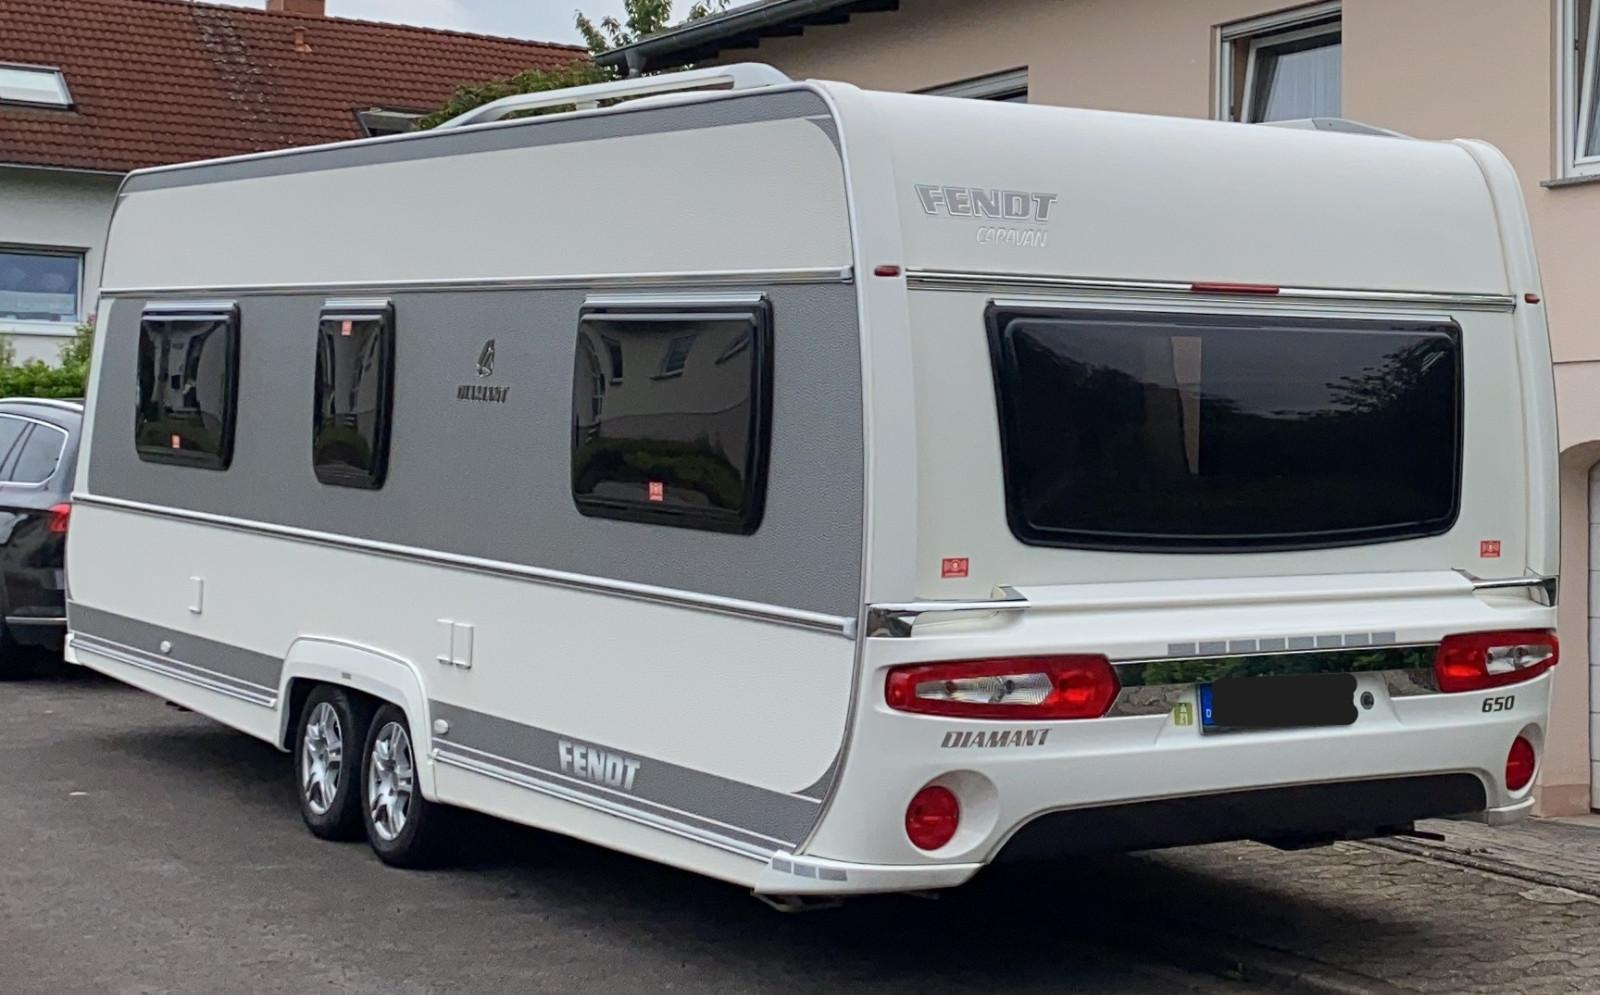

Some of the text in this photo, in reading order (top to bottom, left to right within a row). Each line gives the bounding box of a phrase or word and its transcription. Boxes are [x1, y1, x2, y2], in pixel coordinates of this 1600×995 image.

[914, 184, 1058, 221] FENDT
[976, 226, 1048, 248] CARAVAN
[1205, 708, 1212, 718] D
[1481, 695, 1515, 713] 650
[940, 728, 1053, 748] DIAMANT
[558, 739, 641, 791] FENDT
